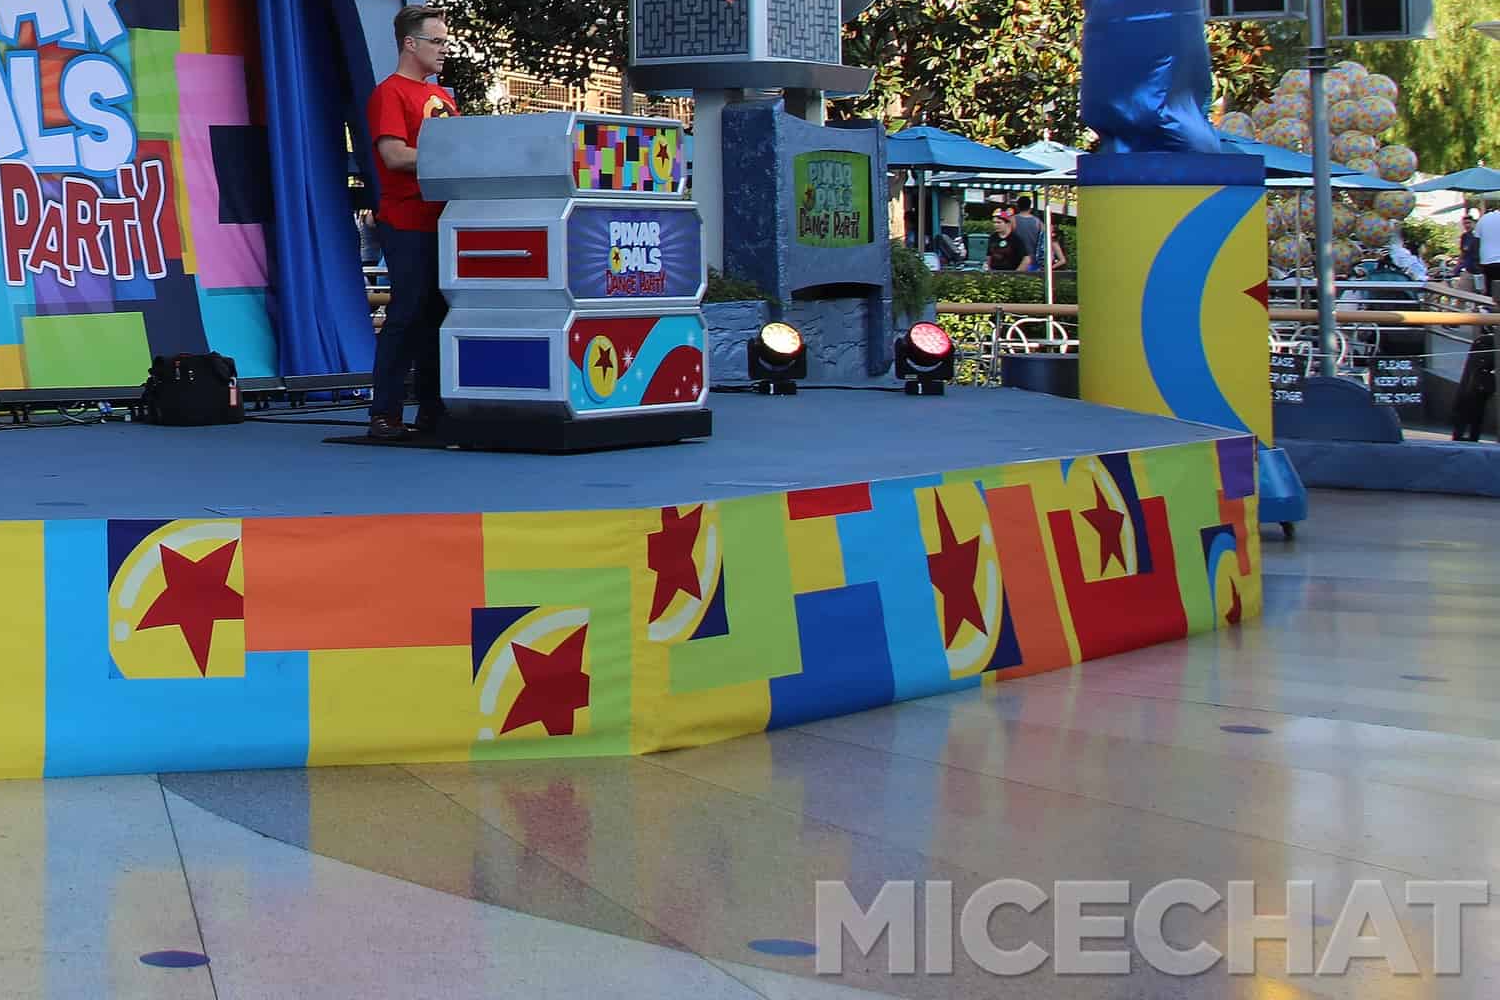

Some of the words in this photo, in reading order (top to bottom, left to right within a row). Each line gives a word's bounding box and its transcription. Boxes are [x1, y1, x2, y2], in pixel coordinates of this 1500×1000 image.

[608, 220, 661, 248] PIXAR
[618, 246, 662, 274] PALS
[604, 269, 637, 296] DANCE
